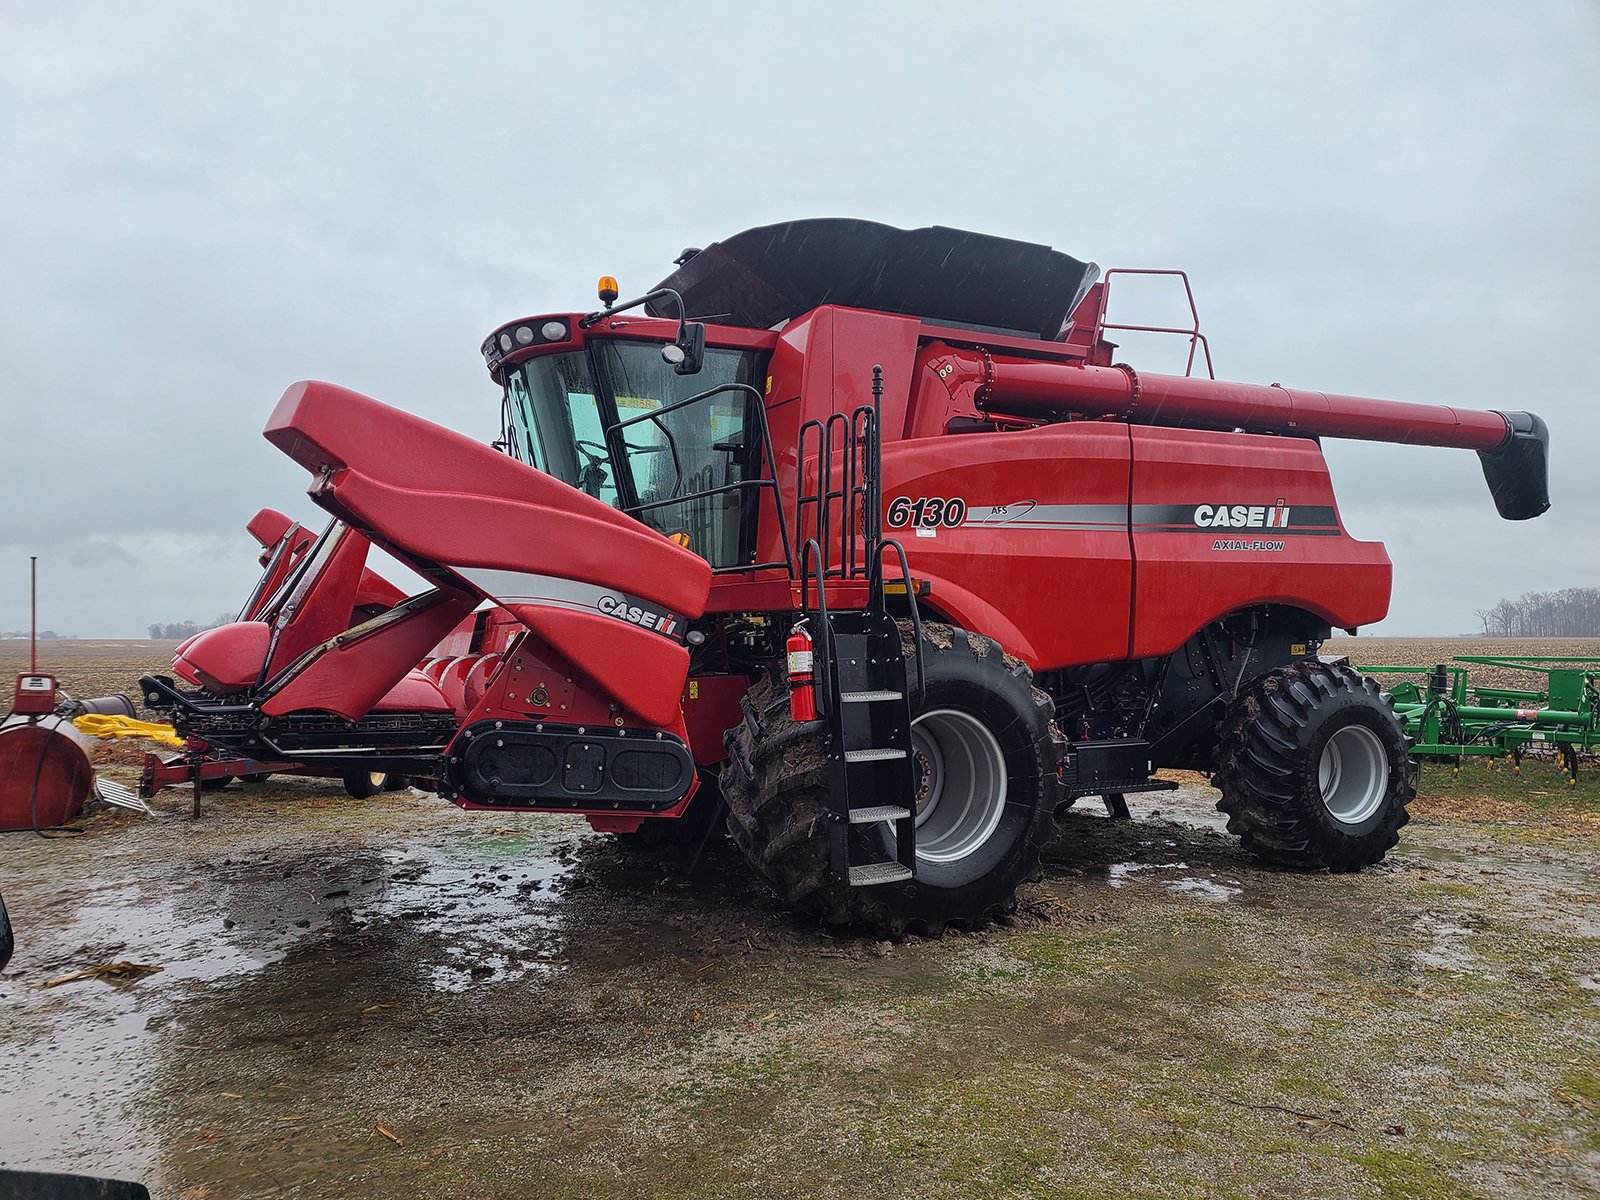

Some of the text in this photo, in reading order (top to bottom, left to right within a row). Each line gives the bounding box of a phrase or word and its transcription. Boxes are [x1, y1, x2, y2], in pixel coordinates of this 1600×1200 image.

[887, 496, 965, 528] 6130
[991, 506, 1008, 515] AFS
[1194, 504, 1266, 528] CASE
[1212, 540, 1285, 552] AXIAL-FLOW
[598, 596, 657, 628] CASE
